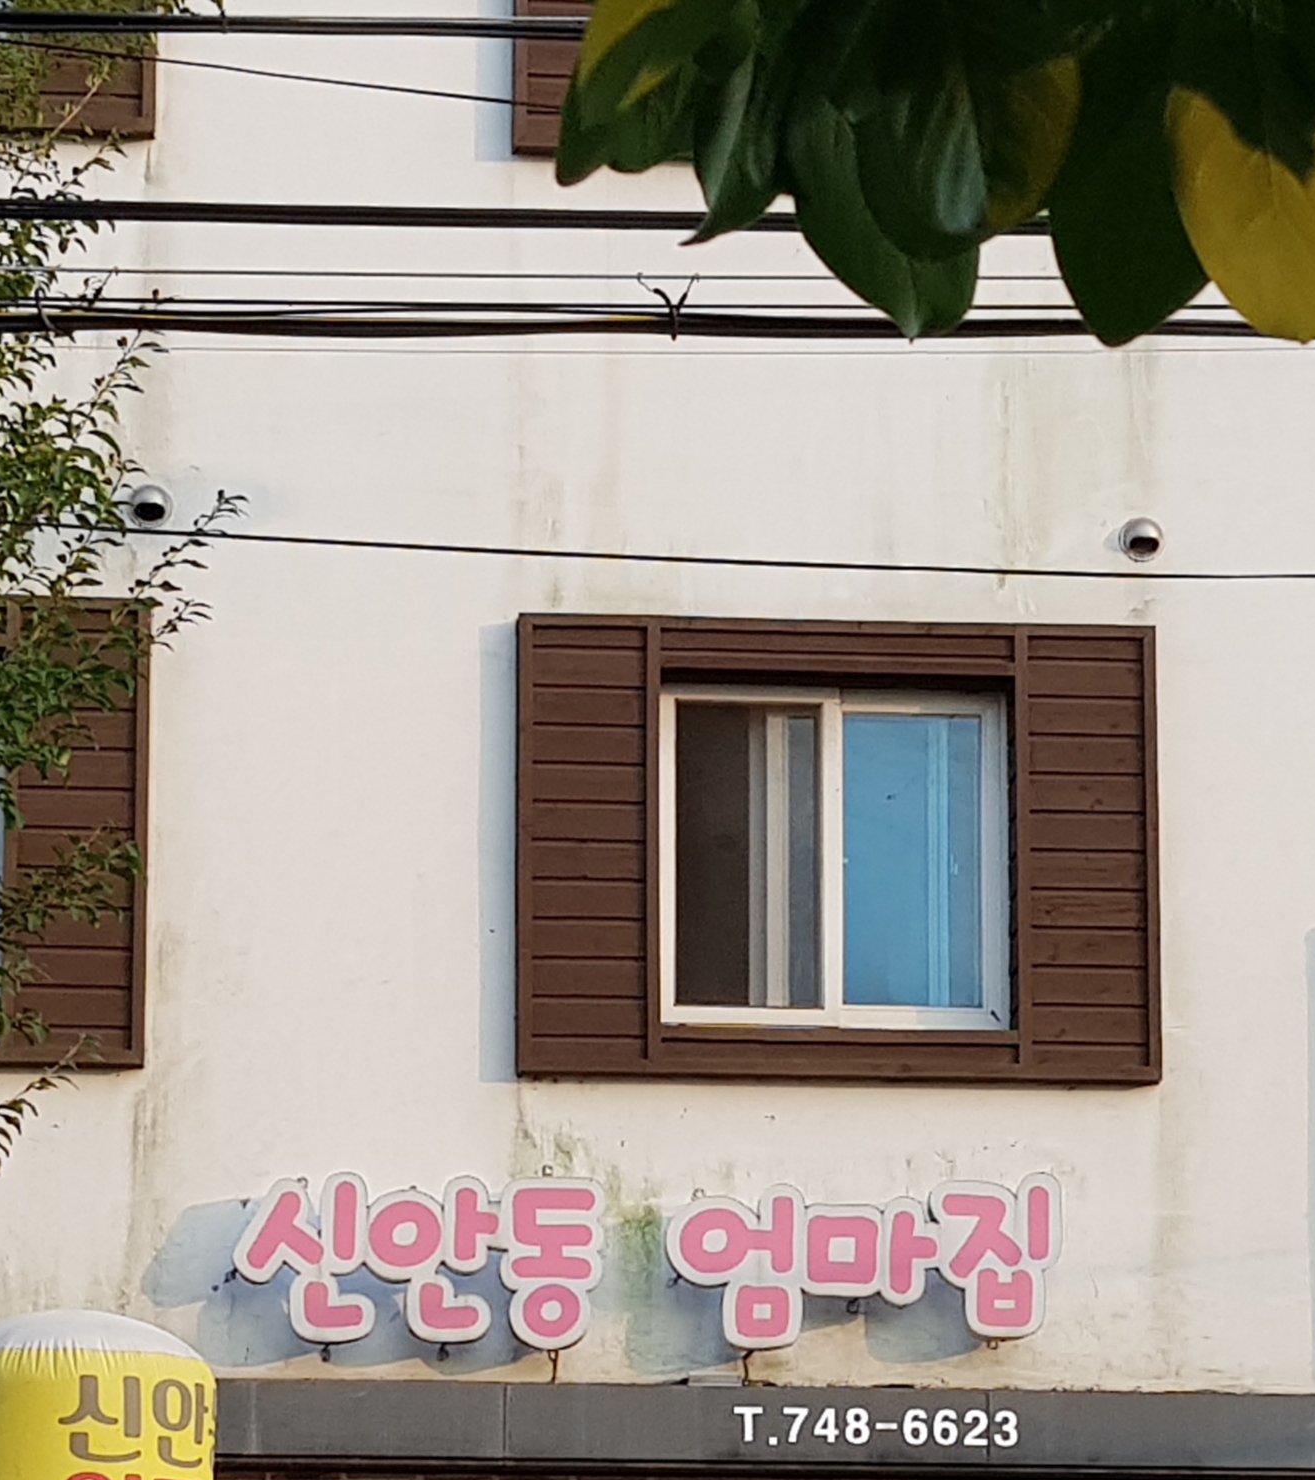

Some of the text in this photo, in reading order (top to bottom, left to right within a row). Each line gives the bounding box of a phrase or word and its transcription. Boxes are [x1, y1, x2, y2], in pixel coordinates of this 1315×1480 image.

[240, 1177, 1056, 1342] 신안동 엄마집
[58, 1374, 216, 1468] 신안
[733, 1406, 1020, 1448] T.748-6623
